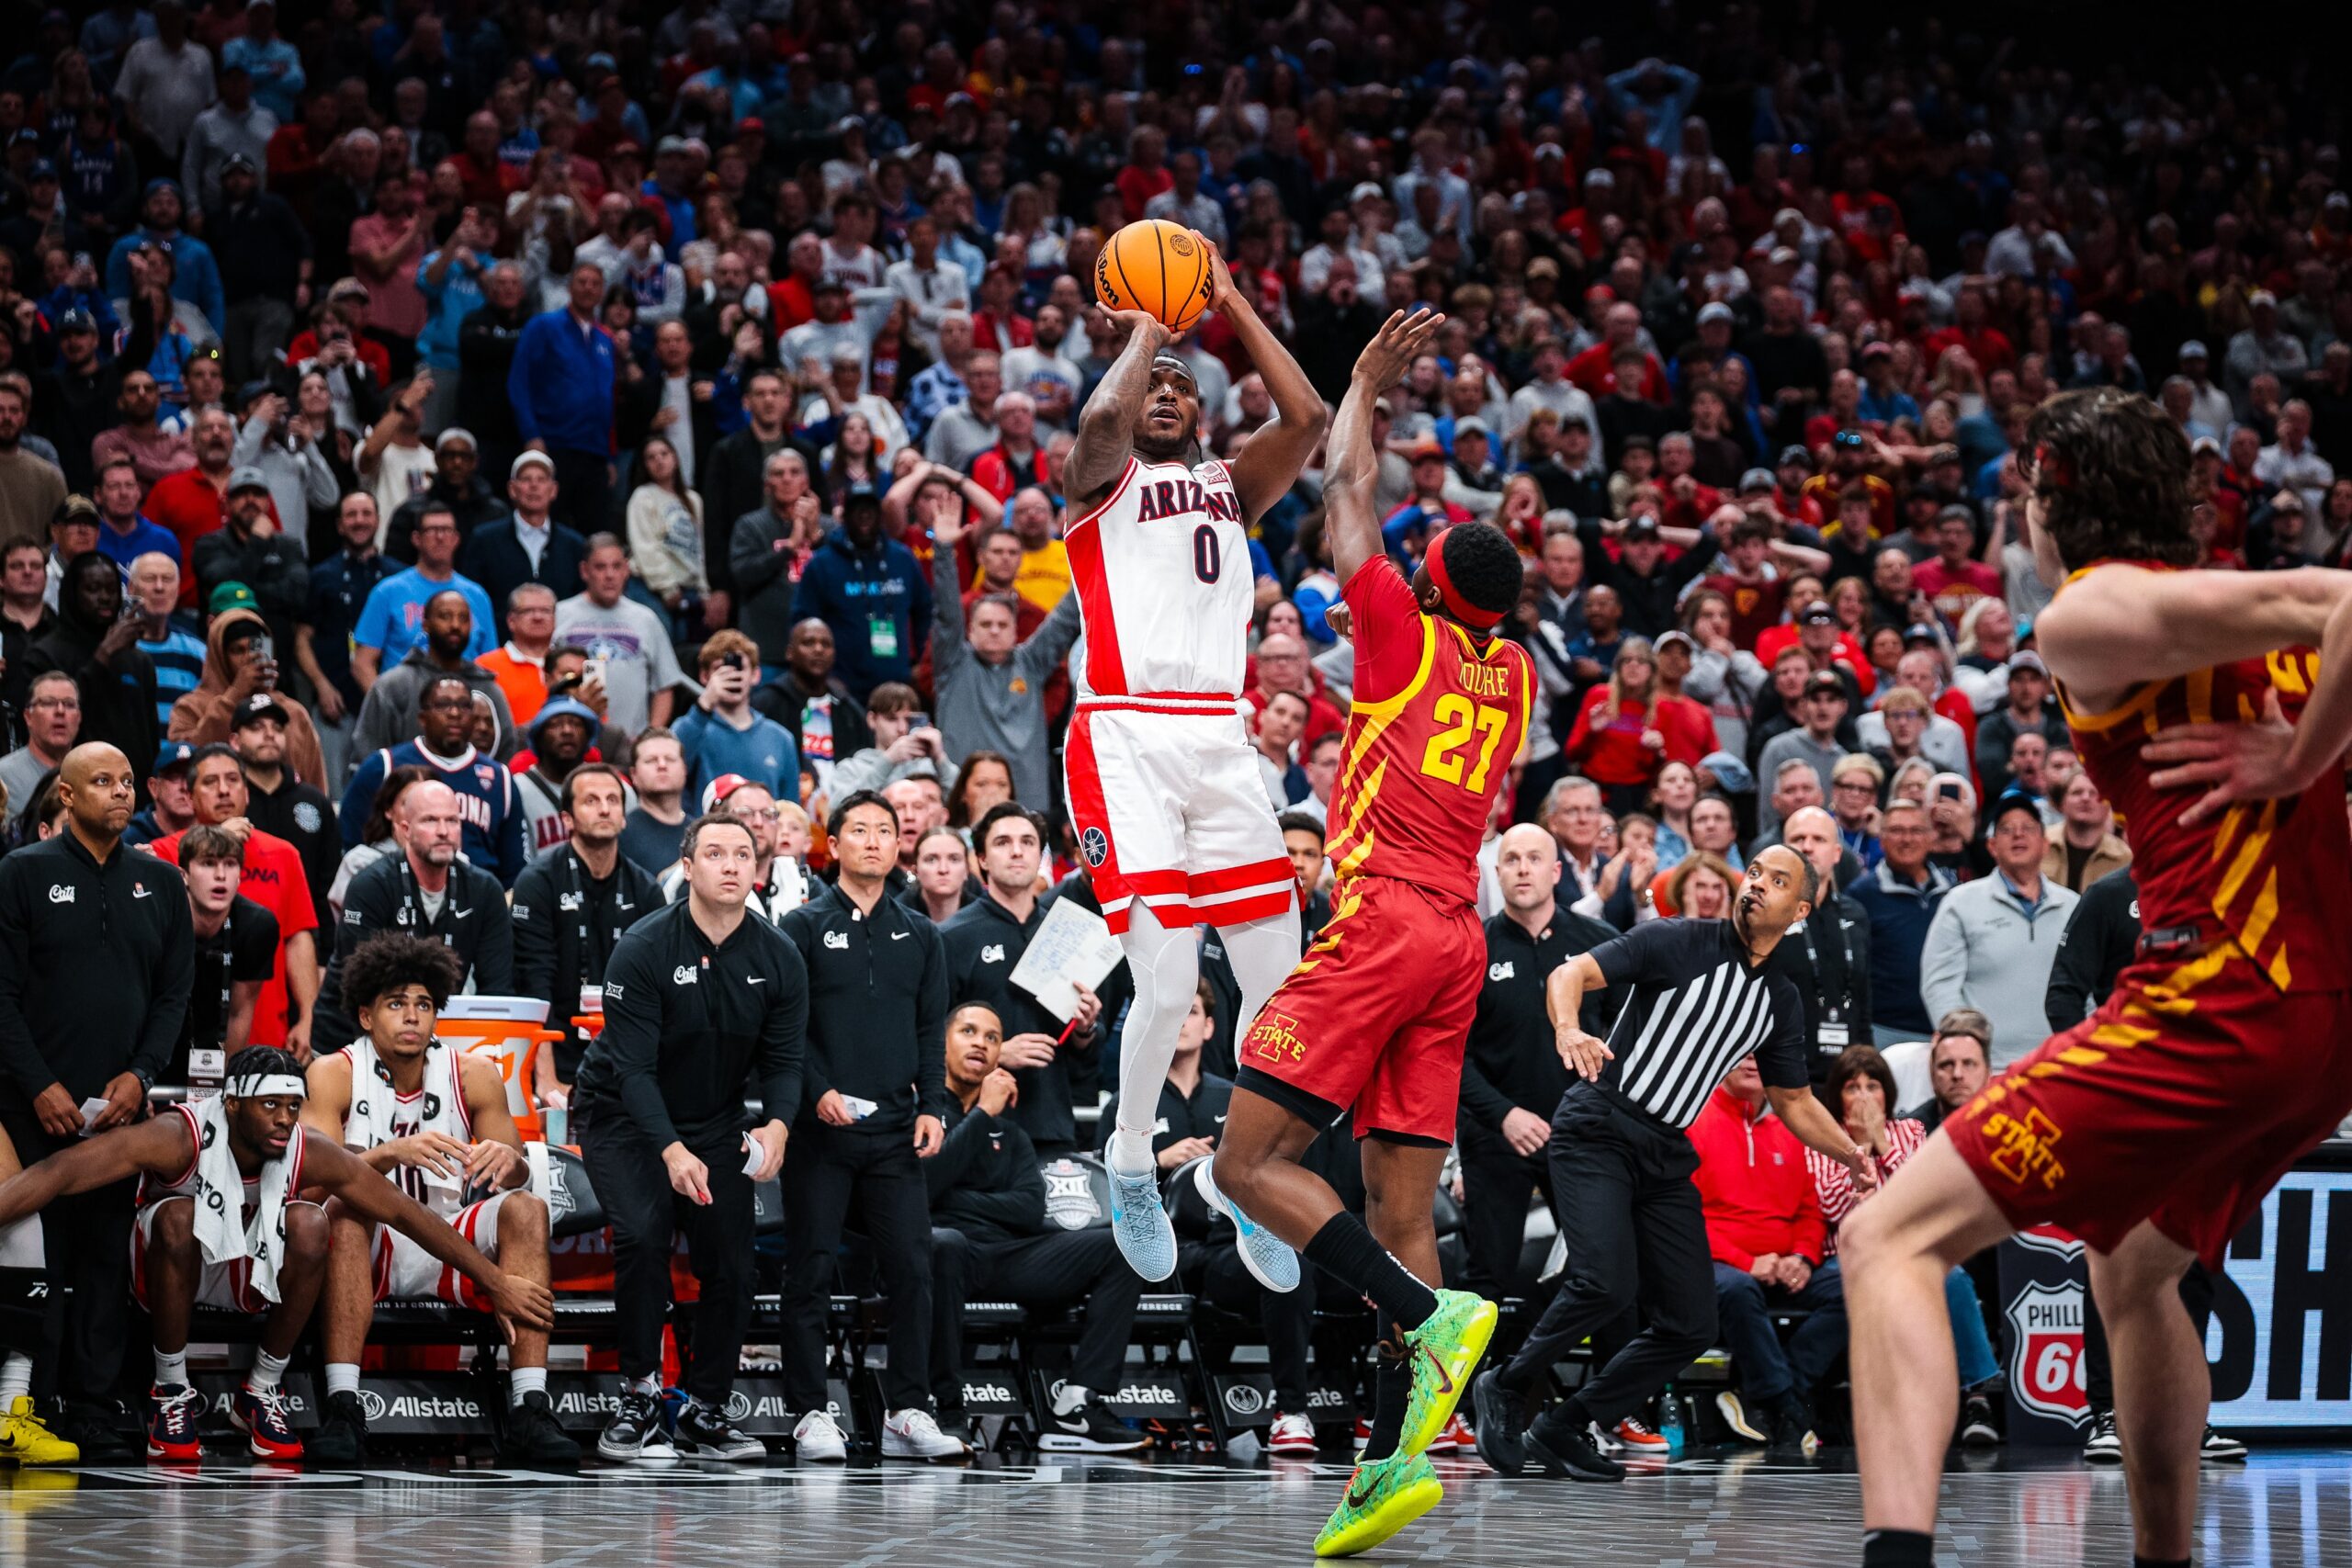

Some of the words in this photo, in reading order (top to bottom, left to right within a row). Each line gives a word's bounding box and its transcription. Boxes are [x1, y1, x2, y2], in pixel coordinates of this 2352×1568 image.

[1137, 479, 1244, 529] ARIZNA
[1193, 524, 1221, 585] 0
[1419, 693, 1509, 795] 27
[1251, 1024, 1307, 1062] STATE
[1981, 1112, 2065, 1190] STATE
[965, 1303, 1019, 1311] NFERENCE
[1136, 1303, 1183, 1311] FERENCE
[2028, 1304, 2084, 1327] PHILL
[556, 1392, 621, 1414] Allsta
[962, 1383, 1012, 1403] state
[1098, 1384, 1177, 1404] state
[1265, 1388, 1344, 1409] Aate
[388, 1395, 481, 1417] Allstate
[753, 1396, 841, 1418] Alle
